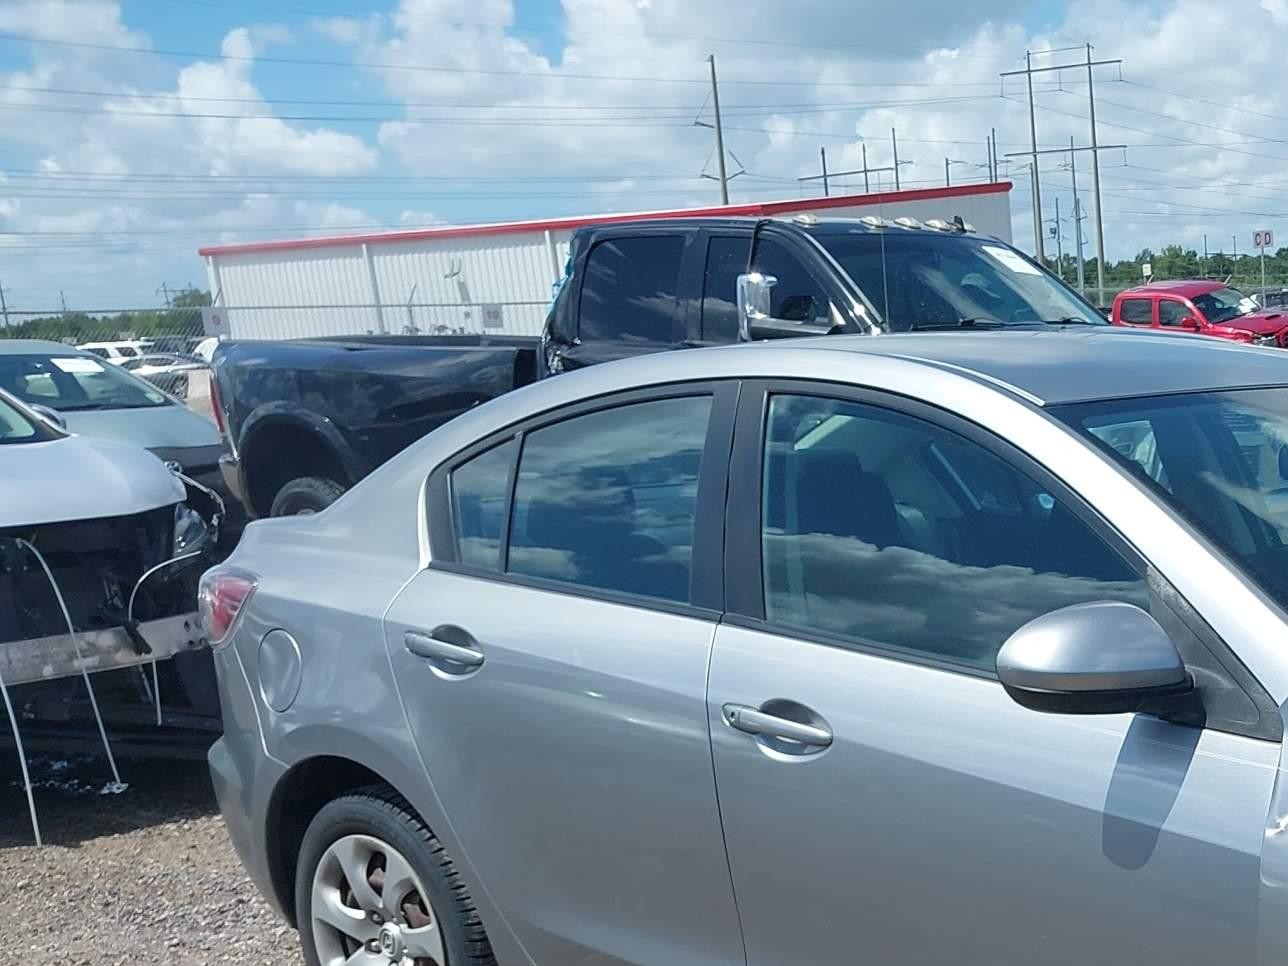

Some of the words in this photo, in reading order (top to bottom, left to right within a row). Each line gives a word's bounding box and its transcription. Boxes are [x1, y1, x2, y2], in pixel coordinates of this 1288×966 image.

[1255, 233, 1262, 246] C
[1264, 232, 1271, 245] D
[486, 310, 500, 320] 10
